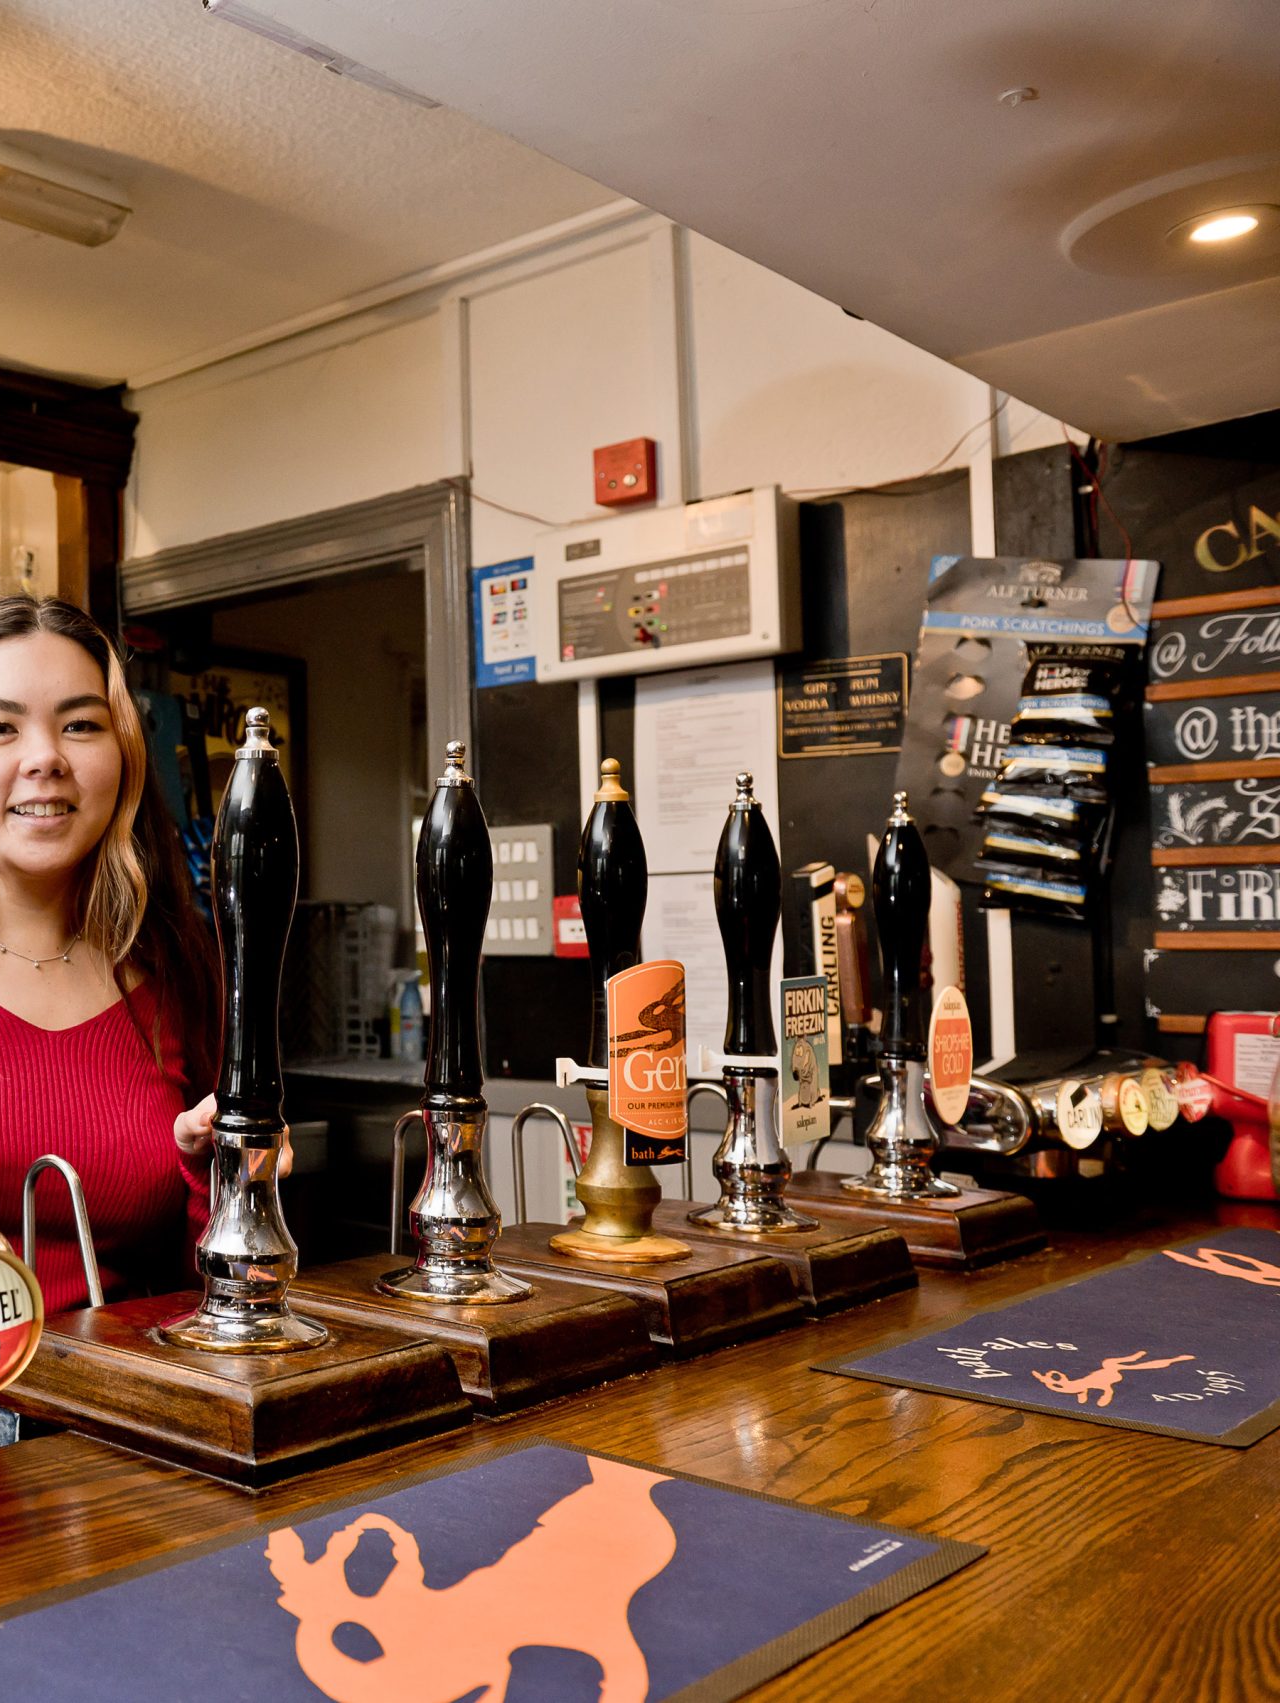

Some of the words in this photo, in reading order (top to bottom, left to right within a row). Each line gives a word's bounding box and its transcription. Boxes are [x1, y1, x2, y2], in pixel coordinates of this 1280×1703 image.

[1194, 503, 1280, 573] CA
[987, 584, 1019, 600] ALF
[1023, 585, 1089, 601] TURNER
[960, 615, 998, 630] PORK
[1003, 618, 1105, 637] SCRATCHINGS
[850, 678, 879, 692] RUM
[784, 697, 829, 712] VODKA
[850, 692, 898, 707] WHISKY
[821, 915, 841, 1017] CARLING
[784, 986, 825, 1017] FIRKIN
[785, 1011, 825, 1040] FREEZIN
[934, 1034, 970, 1054] SHROPSHIRE
[942, 1053, 964, 1075] GOLD
[627, 1102, 646, 1110] OUR
[631, 1147, 655, 1159] bath
[939, 1346, 1013, 1380] bath
[981, 1337, 1079, 1352] ales
